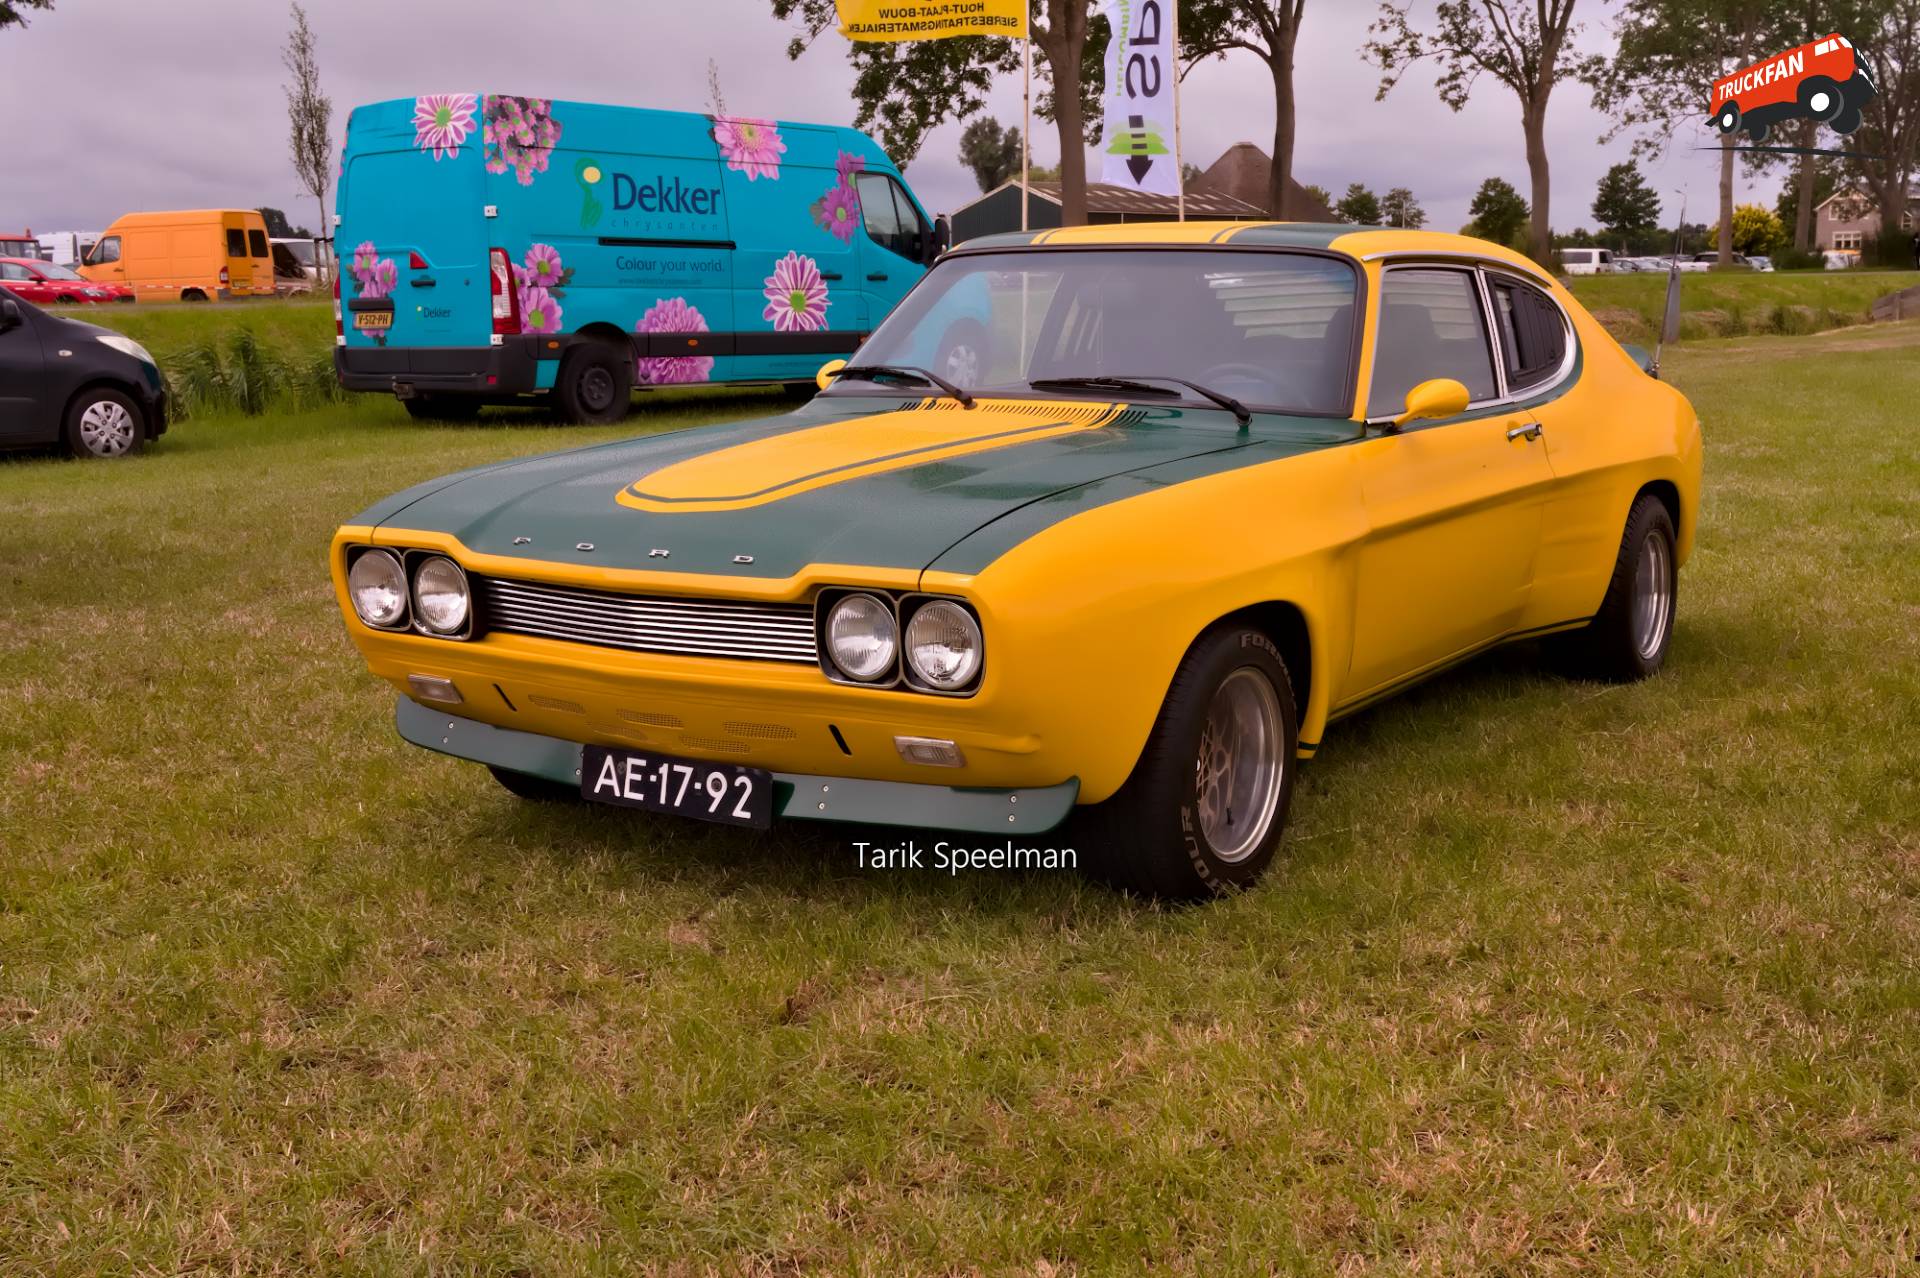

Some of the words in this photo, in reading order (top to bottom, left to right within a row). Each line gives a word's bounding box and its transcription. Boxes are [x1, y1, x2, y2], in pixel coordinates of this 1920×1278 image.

[612, 172, 721, 215] Dekker
[616, 256, 656, 271] Colour
[660, 261, 686, 275] your
[690, 259, 725, 273] world.
[423, 307, 452, 318] Dekker
[513, 536, 754, 564] FORD
[593, 754, 753, 819] AE-17-92
